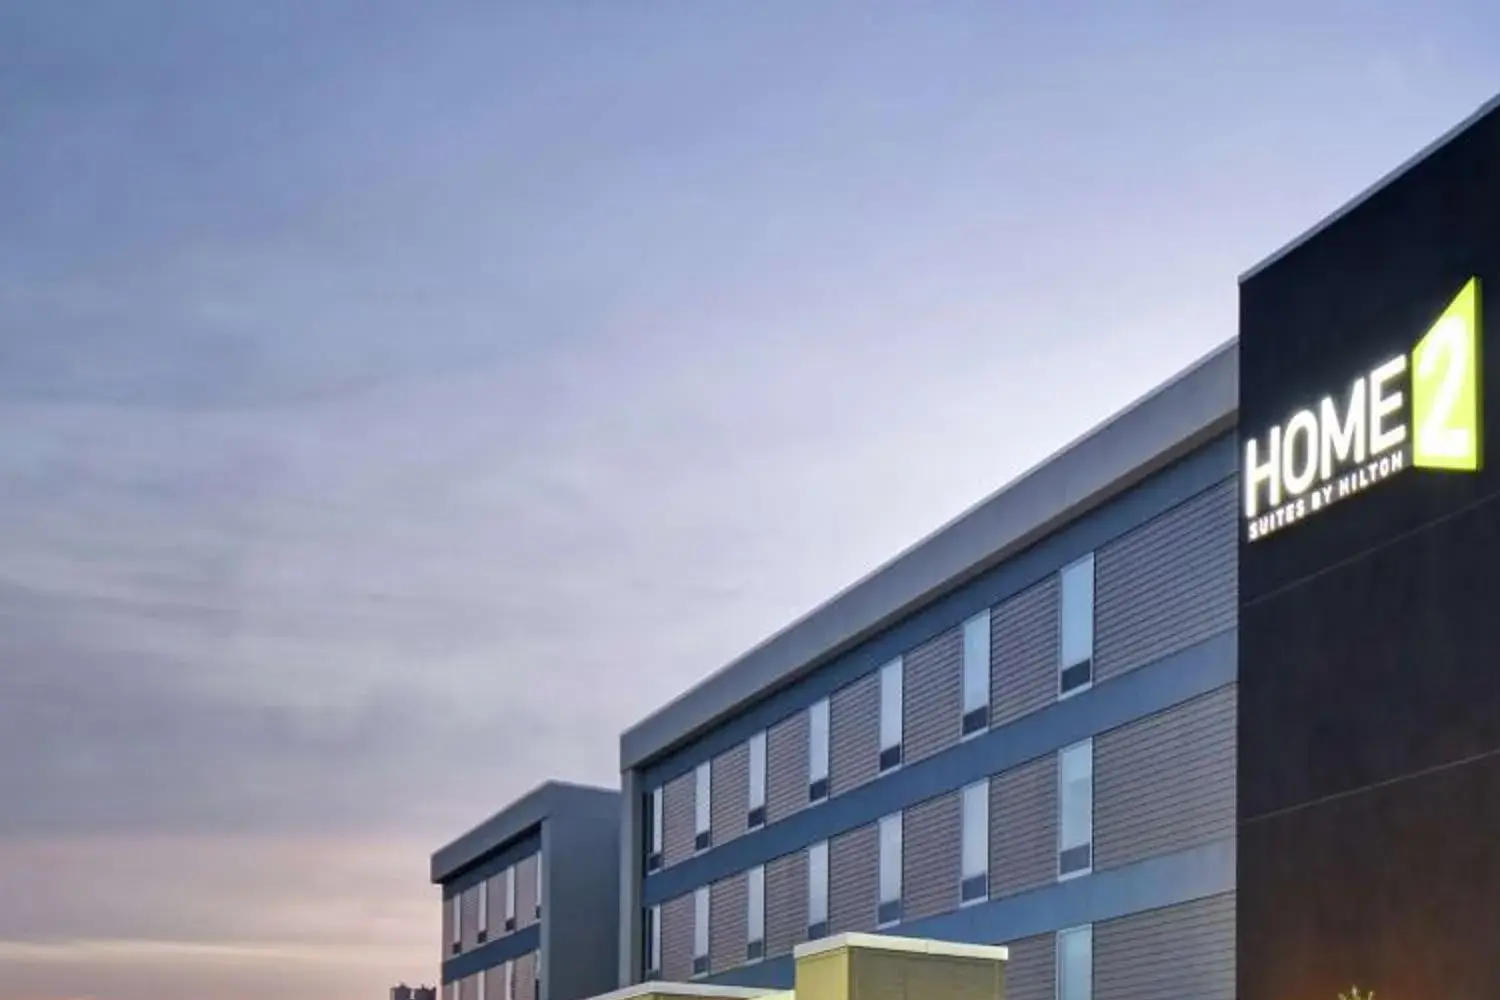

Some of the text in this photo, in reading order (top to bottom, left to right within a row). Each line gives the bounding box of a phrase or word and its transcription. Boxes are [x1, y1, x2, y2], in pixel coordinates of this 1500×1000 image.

[1245, 315, 1470, 519] HOME 2
[1248, 450, 1403, 542] SUITES BY HILTON
